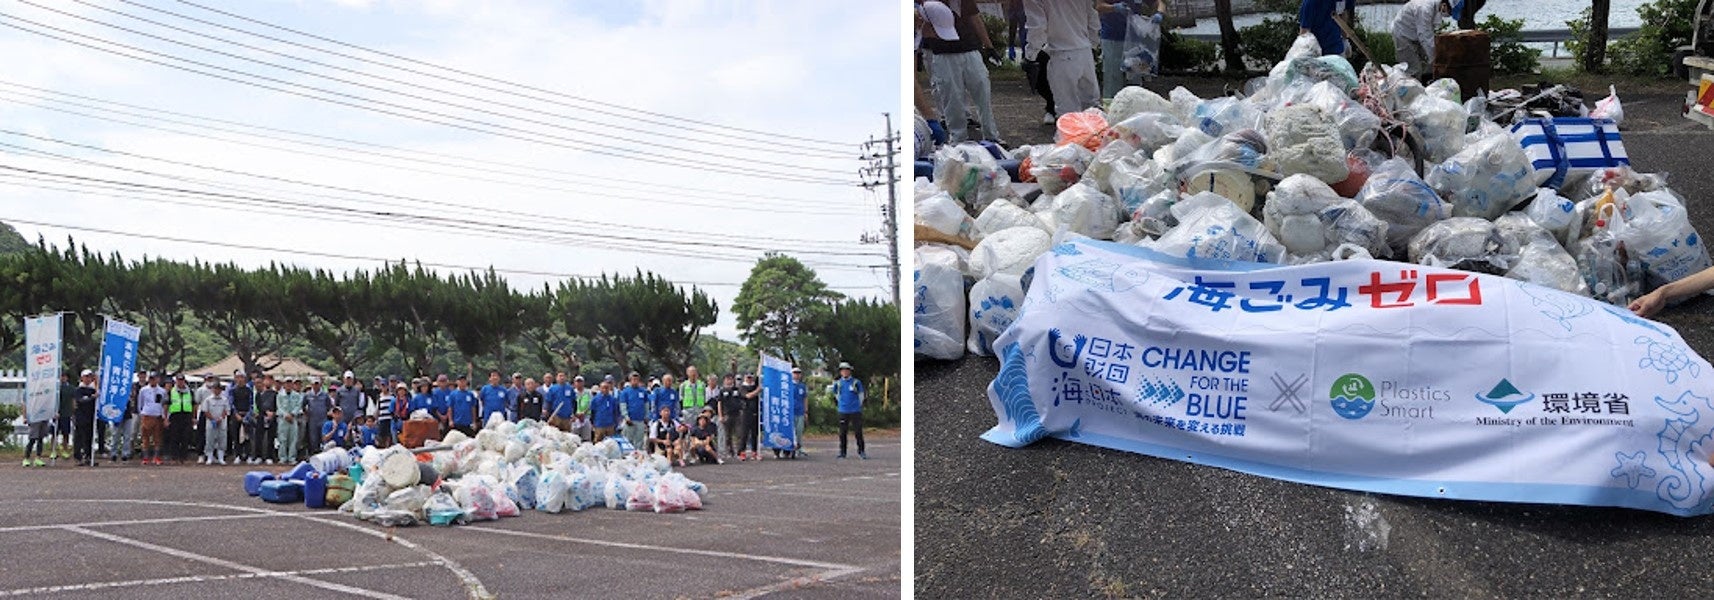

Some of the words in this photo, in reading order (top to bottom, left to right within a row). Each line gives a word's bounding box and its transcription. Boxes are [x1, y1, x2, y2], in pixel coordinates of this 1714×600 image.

[1163, 270, 1482, 312] 海ごみゼロ
[1088, 337, 1135, 361] 日本
[1142, 346, 1251, 373] CHANGE
[1084, 358, 1129, 384] 財団
[1190, 376, 1219, 390] FOR
[1223, 377, 1249, 392] THE
[1380, 380, 1451, 401] Plastics
[1186, 393, 1249, 420] BLUE
[1380, 399, 1434, 419] Smart
[1542, 392, 1630, 415] 環境省
[1134, 411, 1246, 437] 未来を変える挑戦
[1475, 416, 1522, 428] Ministry
[1525, 416, 1537, 426] of
[1540, 416, 1558, 426] the
[1561, 416, 1635, 428] Environment
